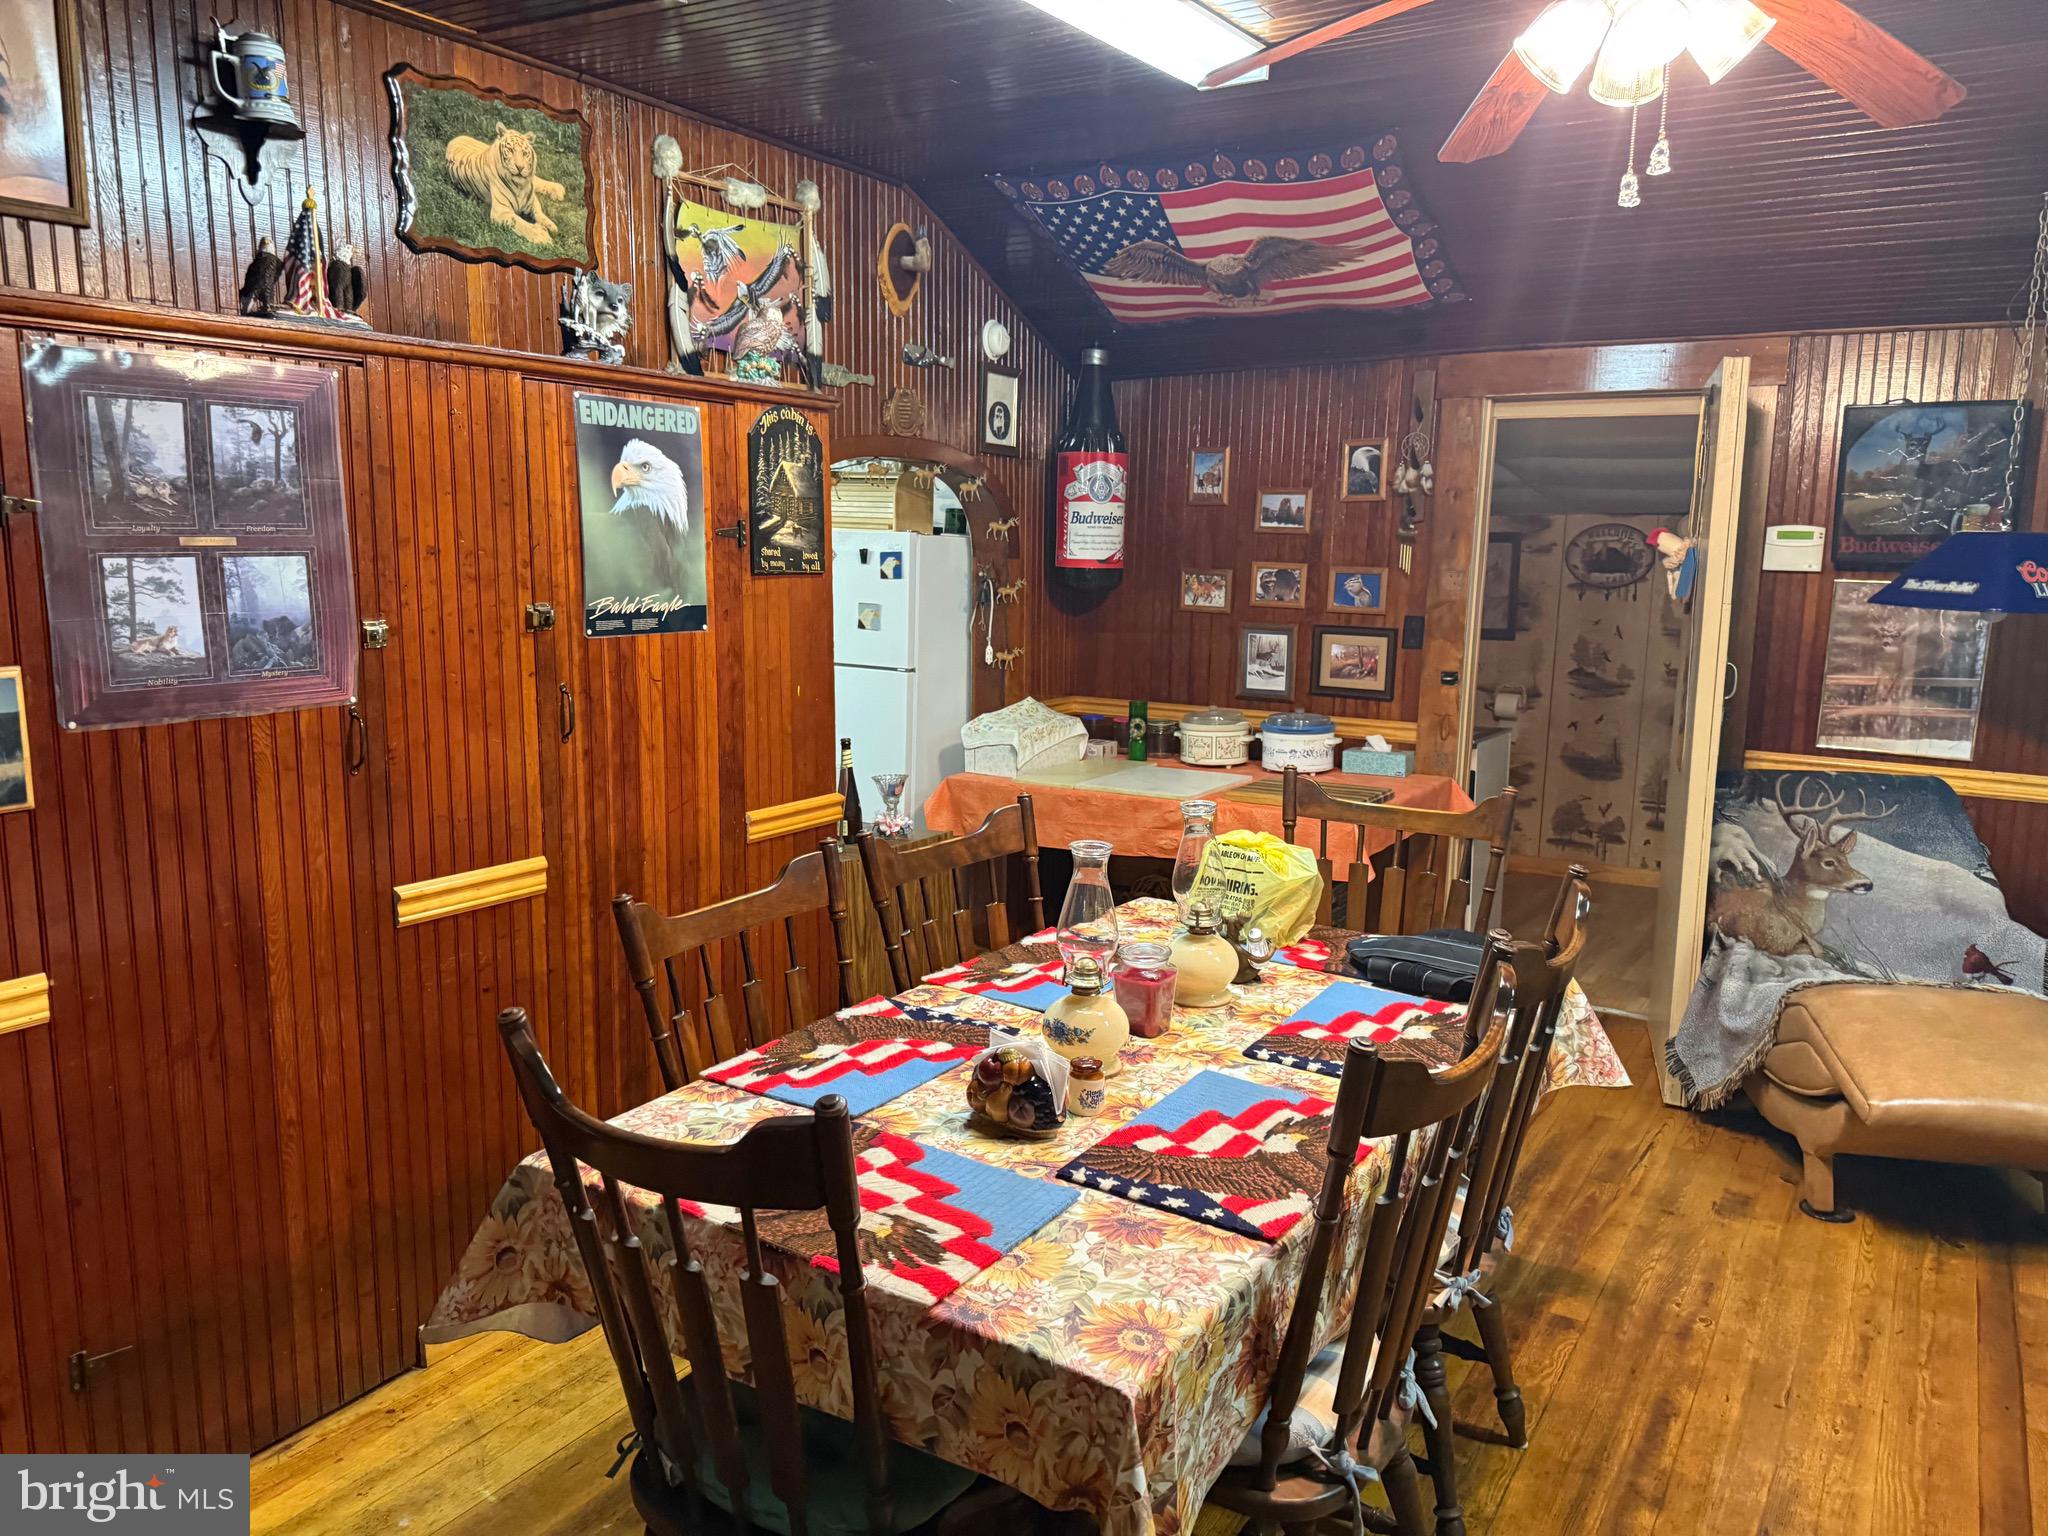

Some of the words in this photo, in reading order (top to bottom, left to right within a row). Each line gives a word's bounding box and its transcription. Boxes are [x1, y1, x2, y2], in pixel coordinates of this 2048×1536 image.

[578, 399, 698, 435] ENDANGERED
[759, 410, 779, 435] This
[780, 407, 805, 427] cabin
[805, 420, 814, 436] is
[1070, 511, 1123, 525] Budweiser
[131, 524, 161, 534] Loyalty
[1839, 536, 1942, 553] Budweise
[761, 546, 781, 557] shared
[802, 551, 819, 560] loved
[760, 558, 769, 571] by
[769, 560, 786, 571] many
[801, 561, 810, 573] by
[810, 561, 821, 570] all
[2016, 561, 2048, 583] Co
[588, 596, 641, 620] Bald
[640, 594, 691, 622] Eagle
[261, 670, 289, 678] Mystery
[147, 678, 179, 687] Nobility
